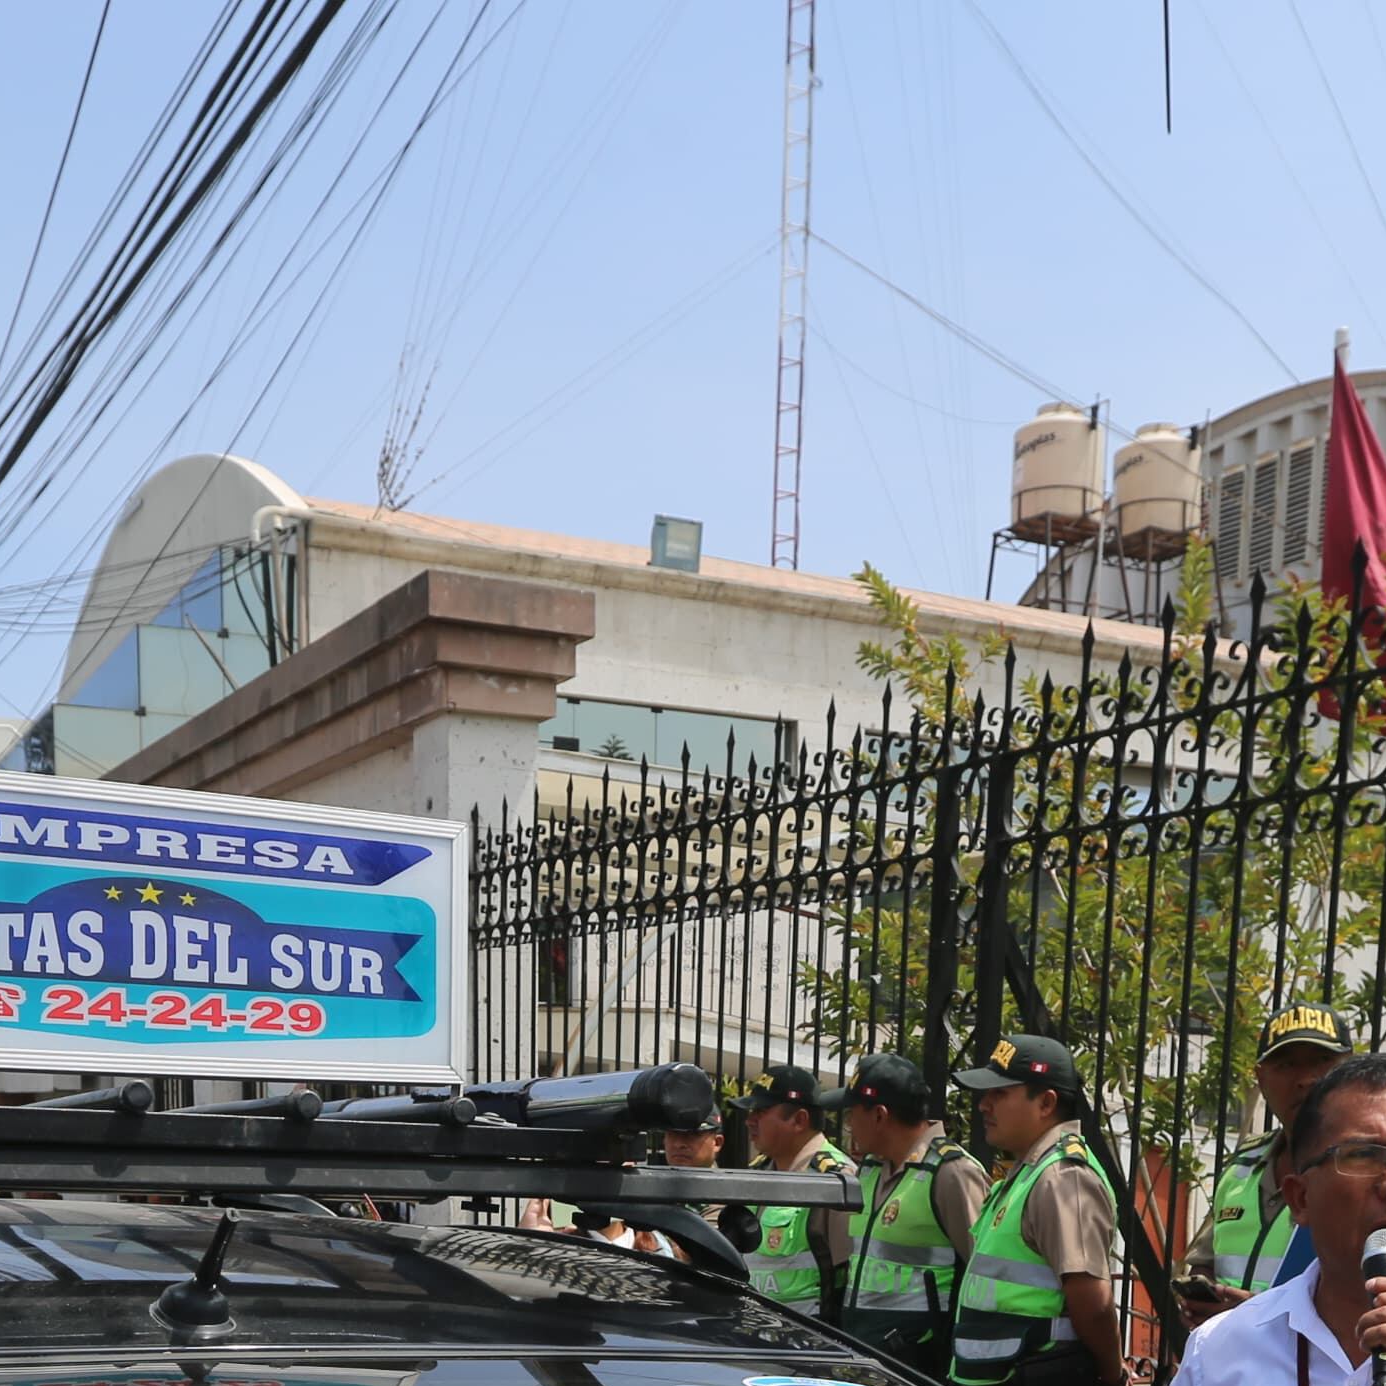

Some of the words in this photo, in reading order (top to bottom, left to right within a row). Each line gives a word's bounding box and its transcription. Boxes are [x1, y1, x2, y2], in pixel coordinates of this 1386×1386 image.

[130, 909, 249, 986] DEL
[269, 934, 385, 995] SUR
[41, 987, 325, 1034] 24-24-29
[1268, 1005, 1338, 1047] POLICIA
